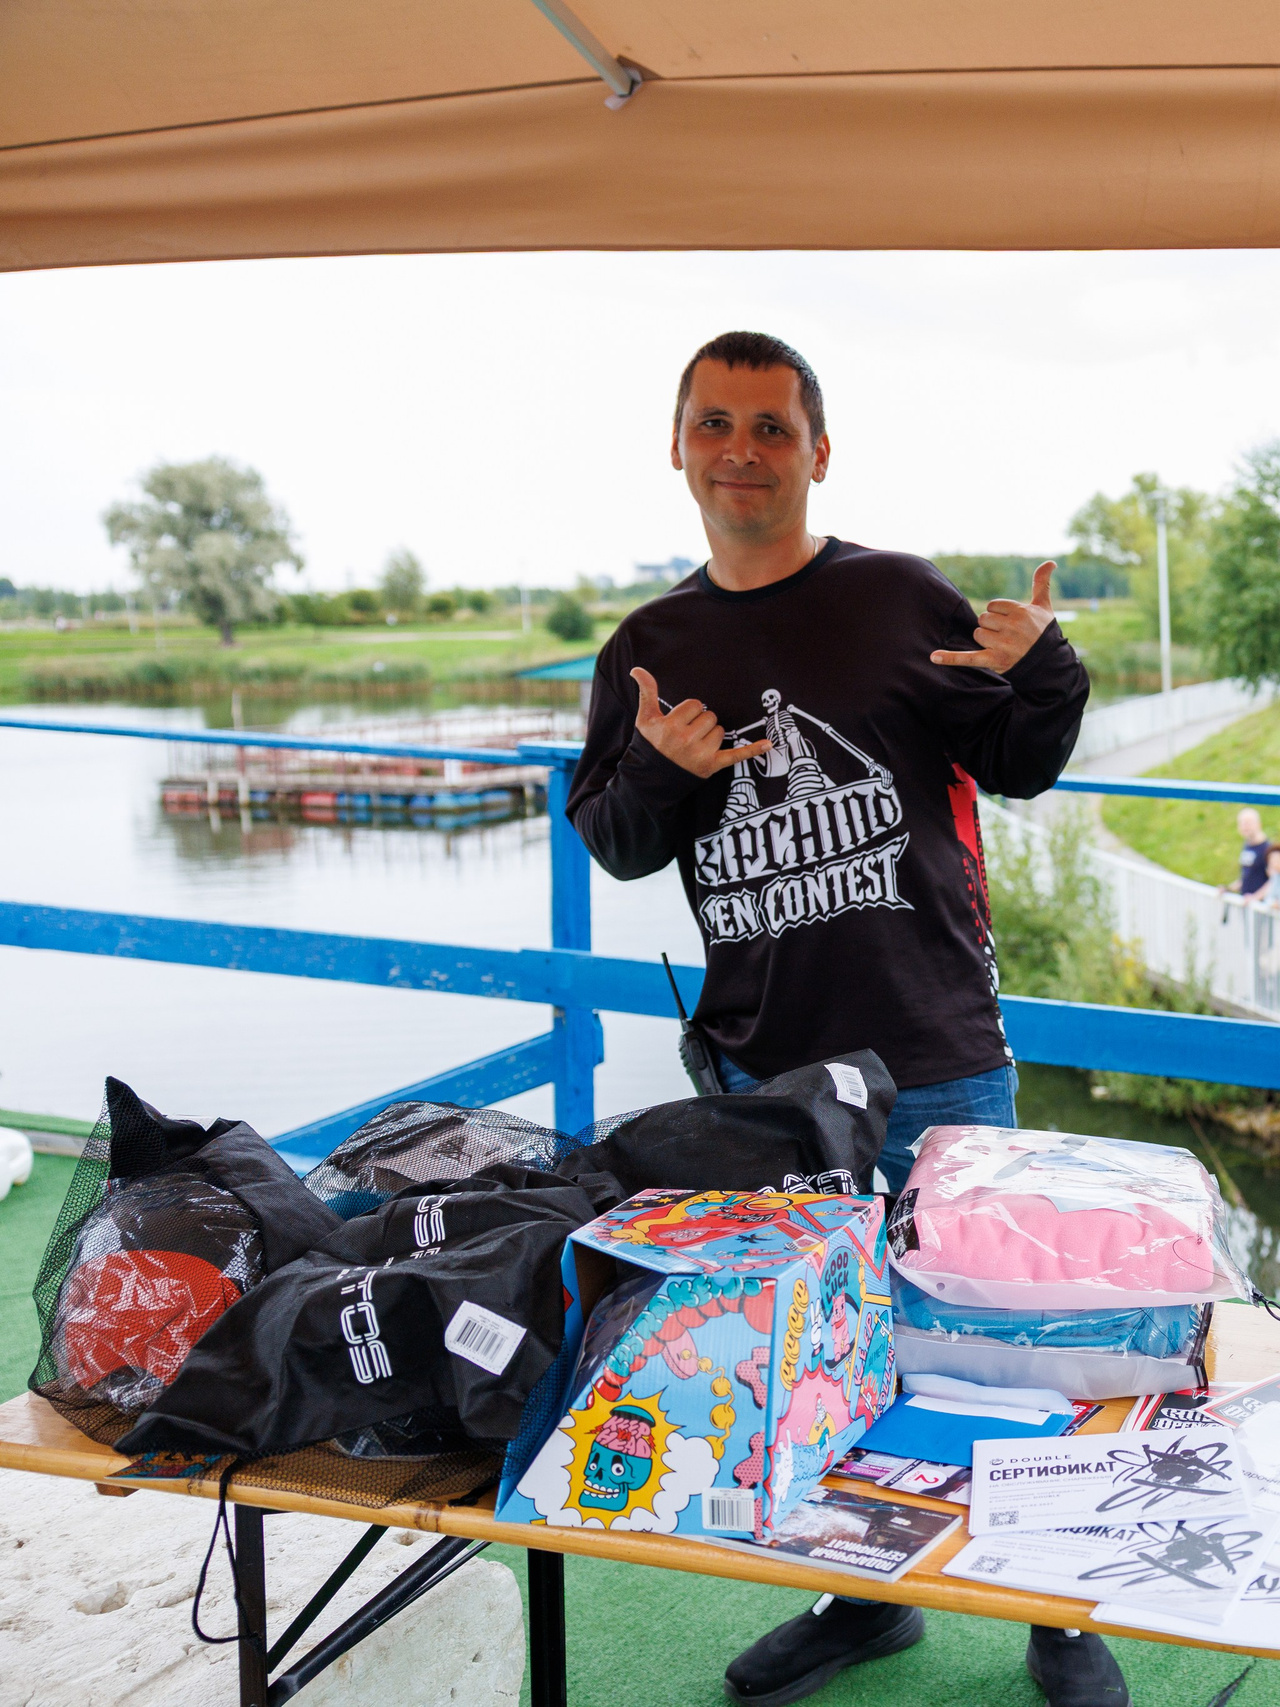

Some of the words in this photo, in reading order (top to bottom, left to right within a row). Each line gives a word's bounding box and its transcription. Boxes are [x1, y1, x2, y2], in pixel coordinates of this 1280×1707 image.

[703, 892, 761, 939] EN
[764, 843, 902, 933] CONTEST
[824, 1251, 849, 1287] GOOD
[825, 1269, 849, 1302] LUCK
[853, 1311, 874, 1387] KEEP
[602, 1415, 651, 1439] KEEP
[617, 1428, 632, 1441] YA
[595, 1427, 652, 1459] HEAD
[1009, 1454, 1072, 1464] DOUBLE
[914, 1474, 939, 1484] 2
[989, 1461, 1117, 1482] СЕРТИФИКАТ
[1046, 1524, 1140, 1543] ФИКАТ
[808, 1547, 897, 1572] ПОДАРОЧНЫЙ
[825, 1539, 908, 1563] СЕРТИФИКАТ
